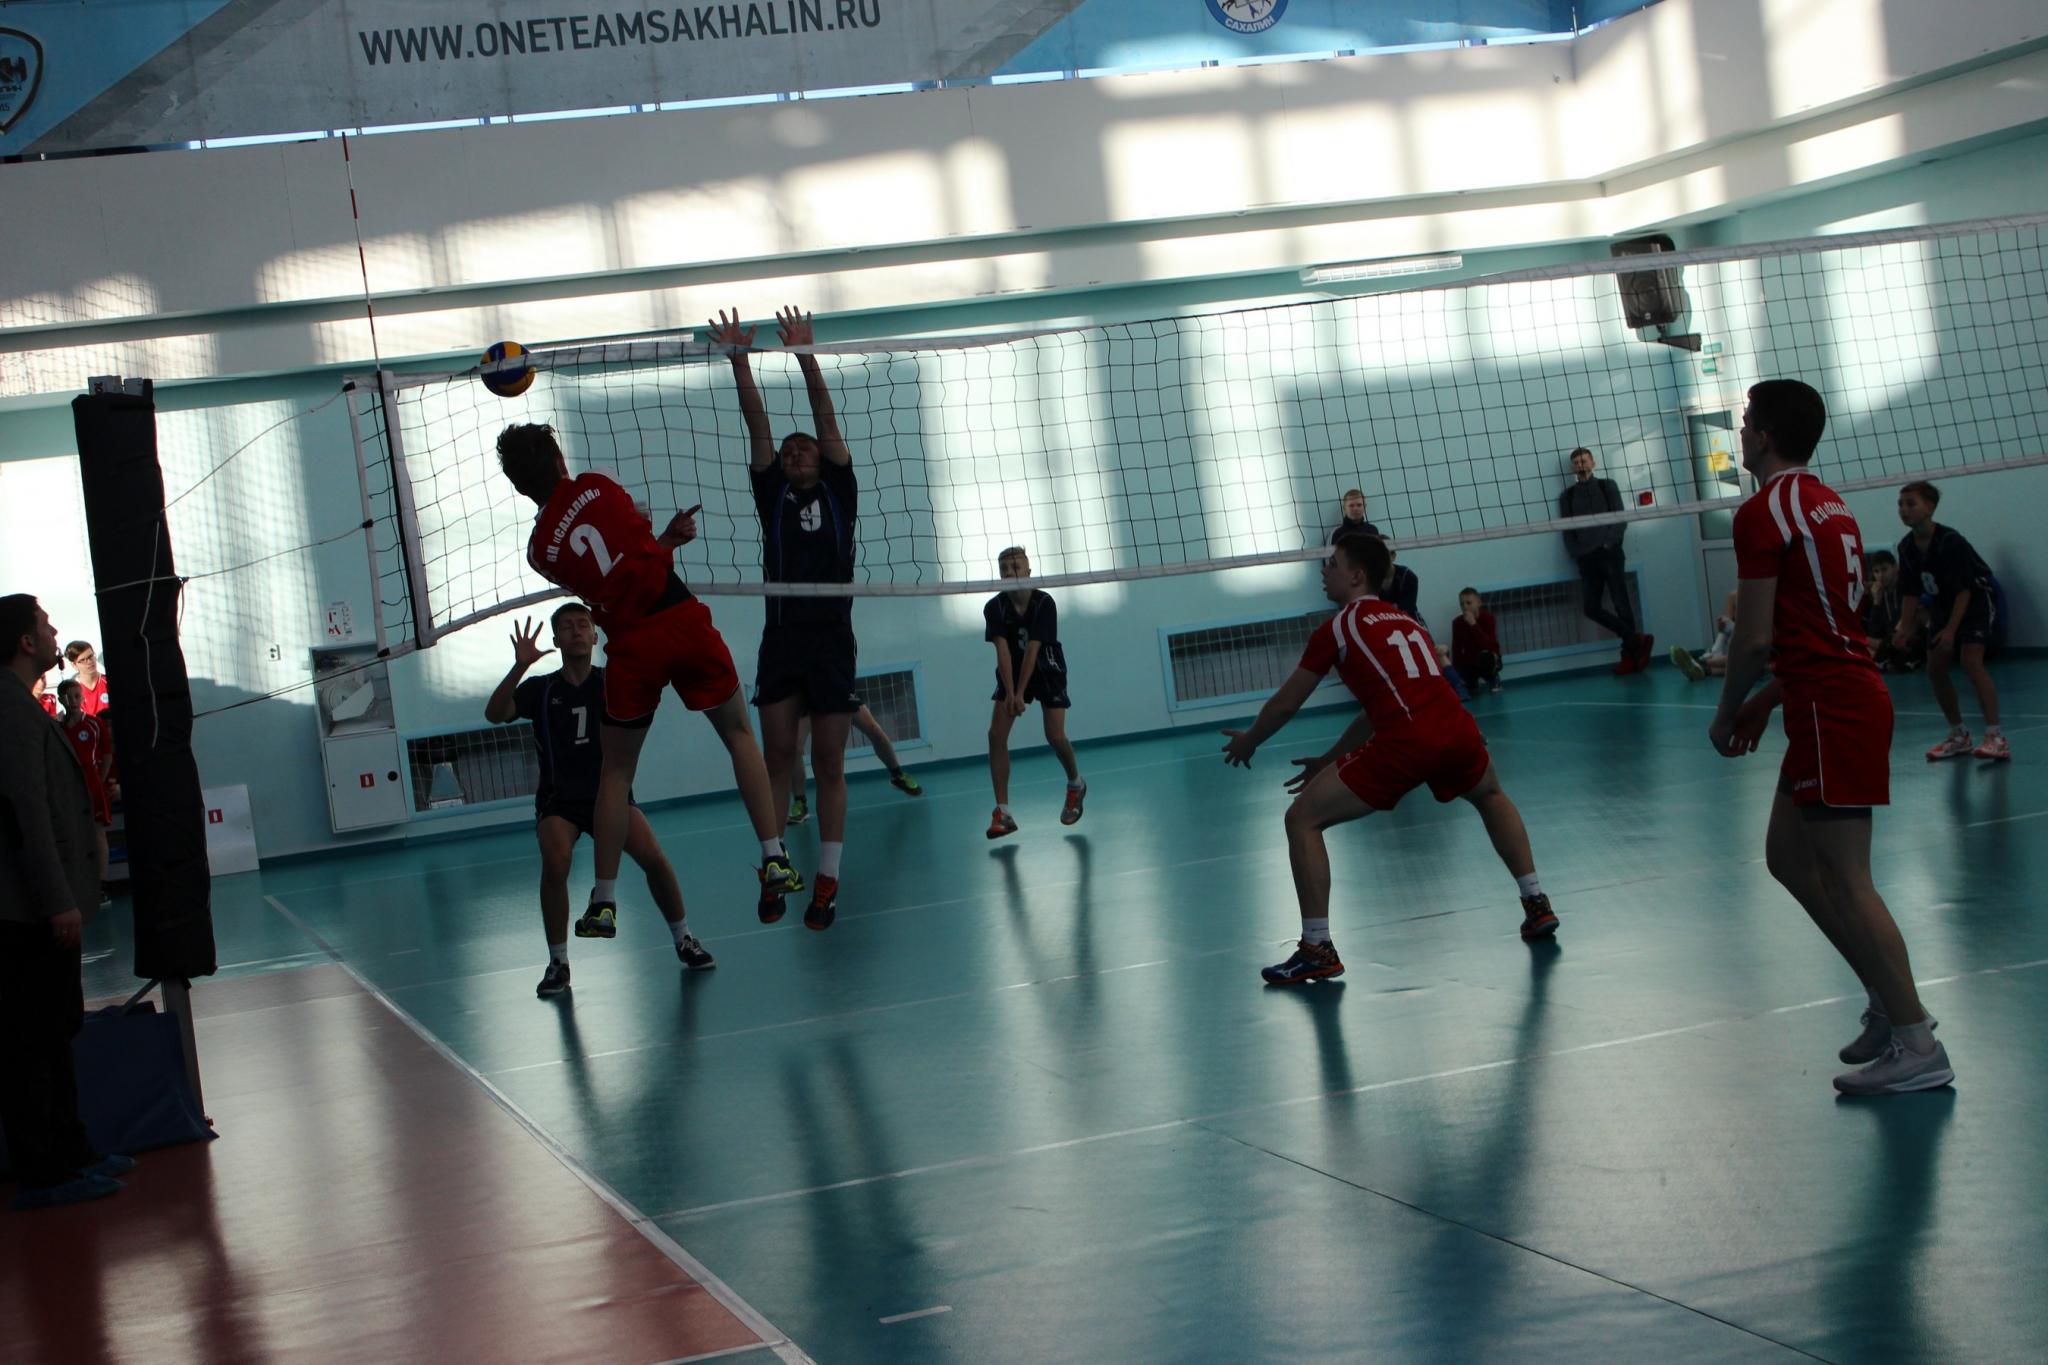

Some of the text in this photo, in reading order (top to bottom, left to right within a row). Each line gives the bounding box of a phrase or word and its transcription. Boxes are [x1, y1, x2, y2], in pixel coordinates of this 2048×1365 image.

[359, 0, 881, 65] WWW.ONETEAMSAKHALIN.RU
[1225, 15, 1275, 32] САХАЛИН
[800, 499, 822, 532] 9
[569, 523, 625, 577] 2
[1841, 534, 1864, 612] 5
[1387, 630, 1440, 678] 11
